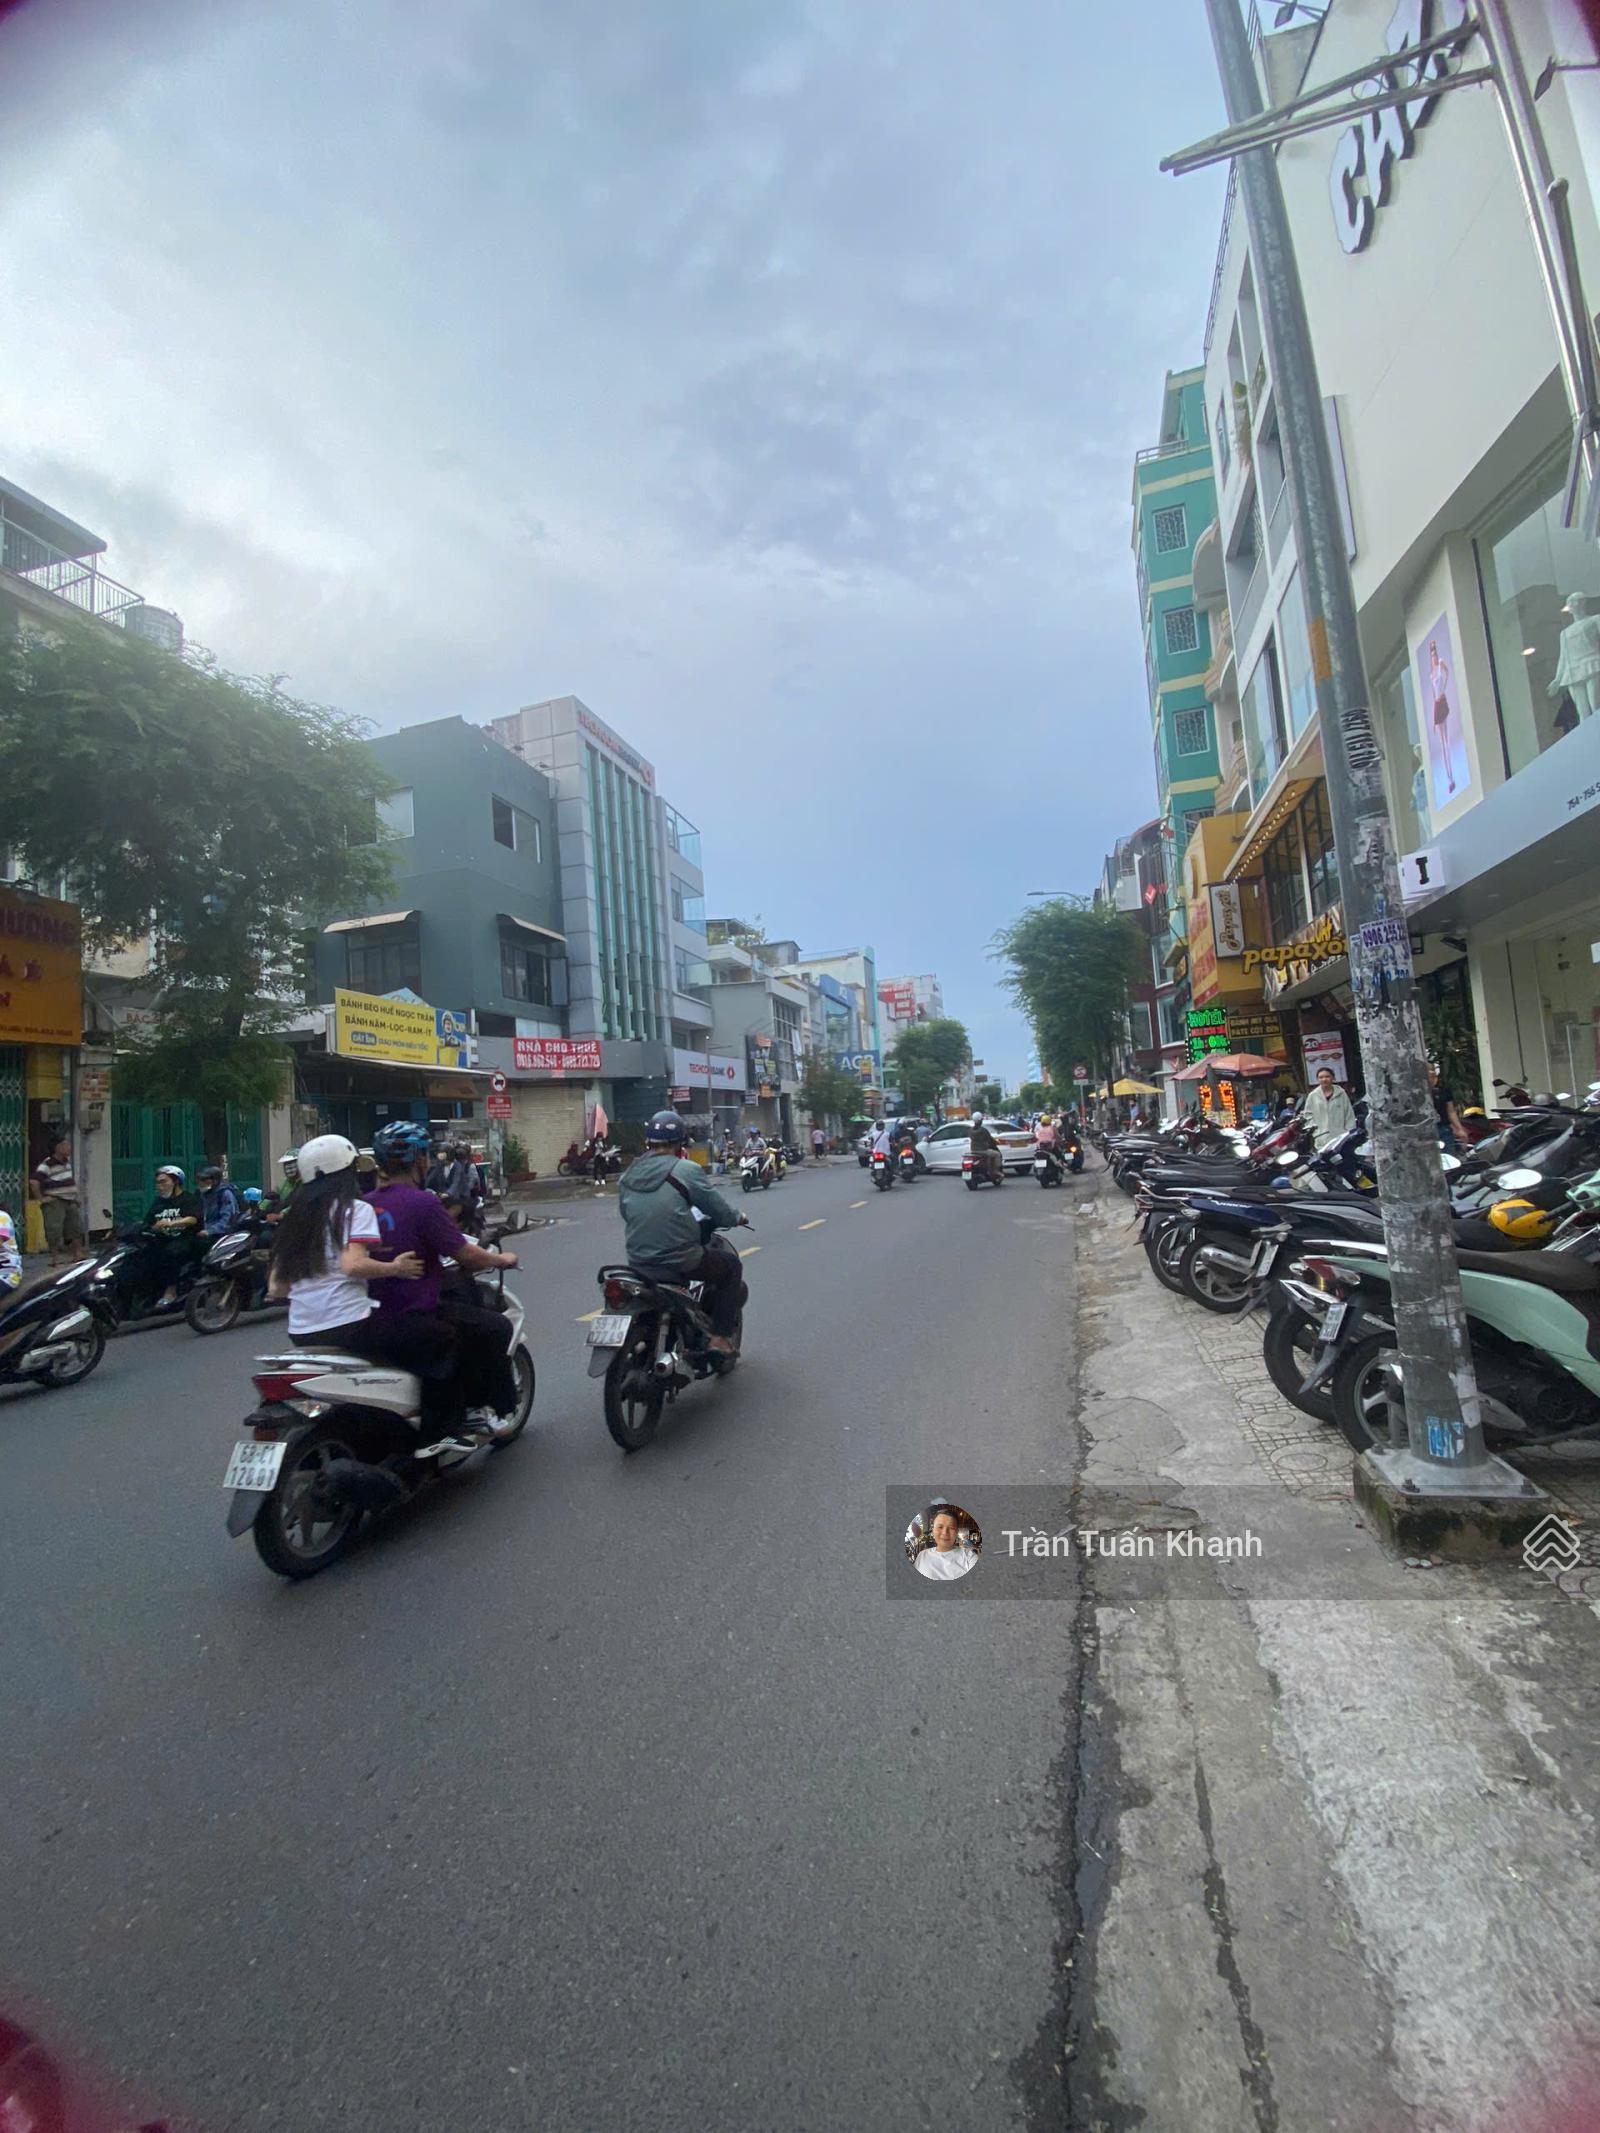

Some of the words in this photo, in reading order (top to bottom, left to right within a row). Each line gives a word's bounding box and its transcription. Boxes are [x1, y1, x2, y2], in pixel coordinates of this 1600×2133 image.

[1188, 1008, 1226, 1027] HOTEL
[517, 1040, 542, 1053] NHÀ
[545, 1042, 568, 1053] CHO
[571, 1041, 597, 1053] THUÊ
[689, 1063, 725, 1076] TECHCOBANK
